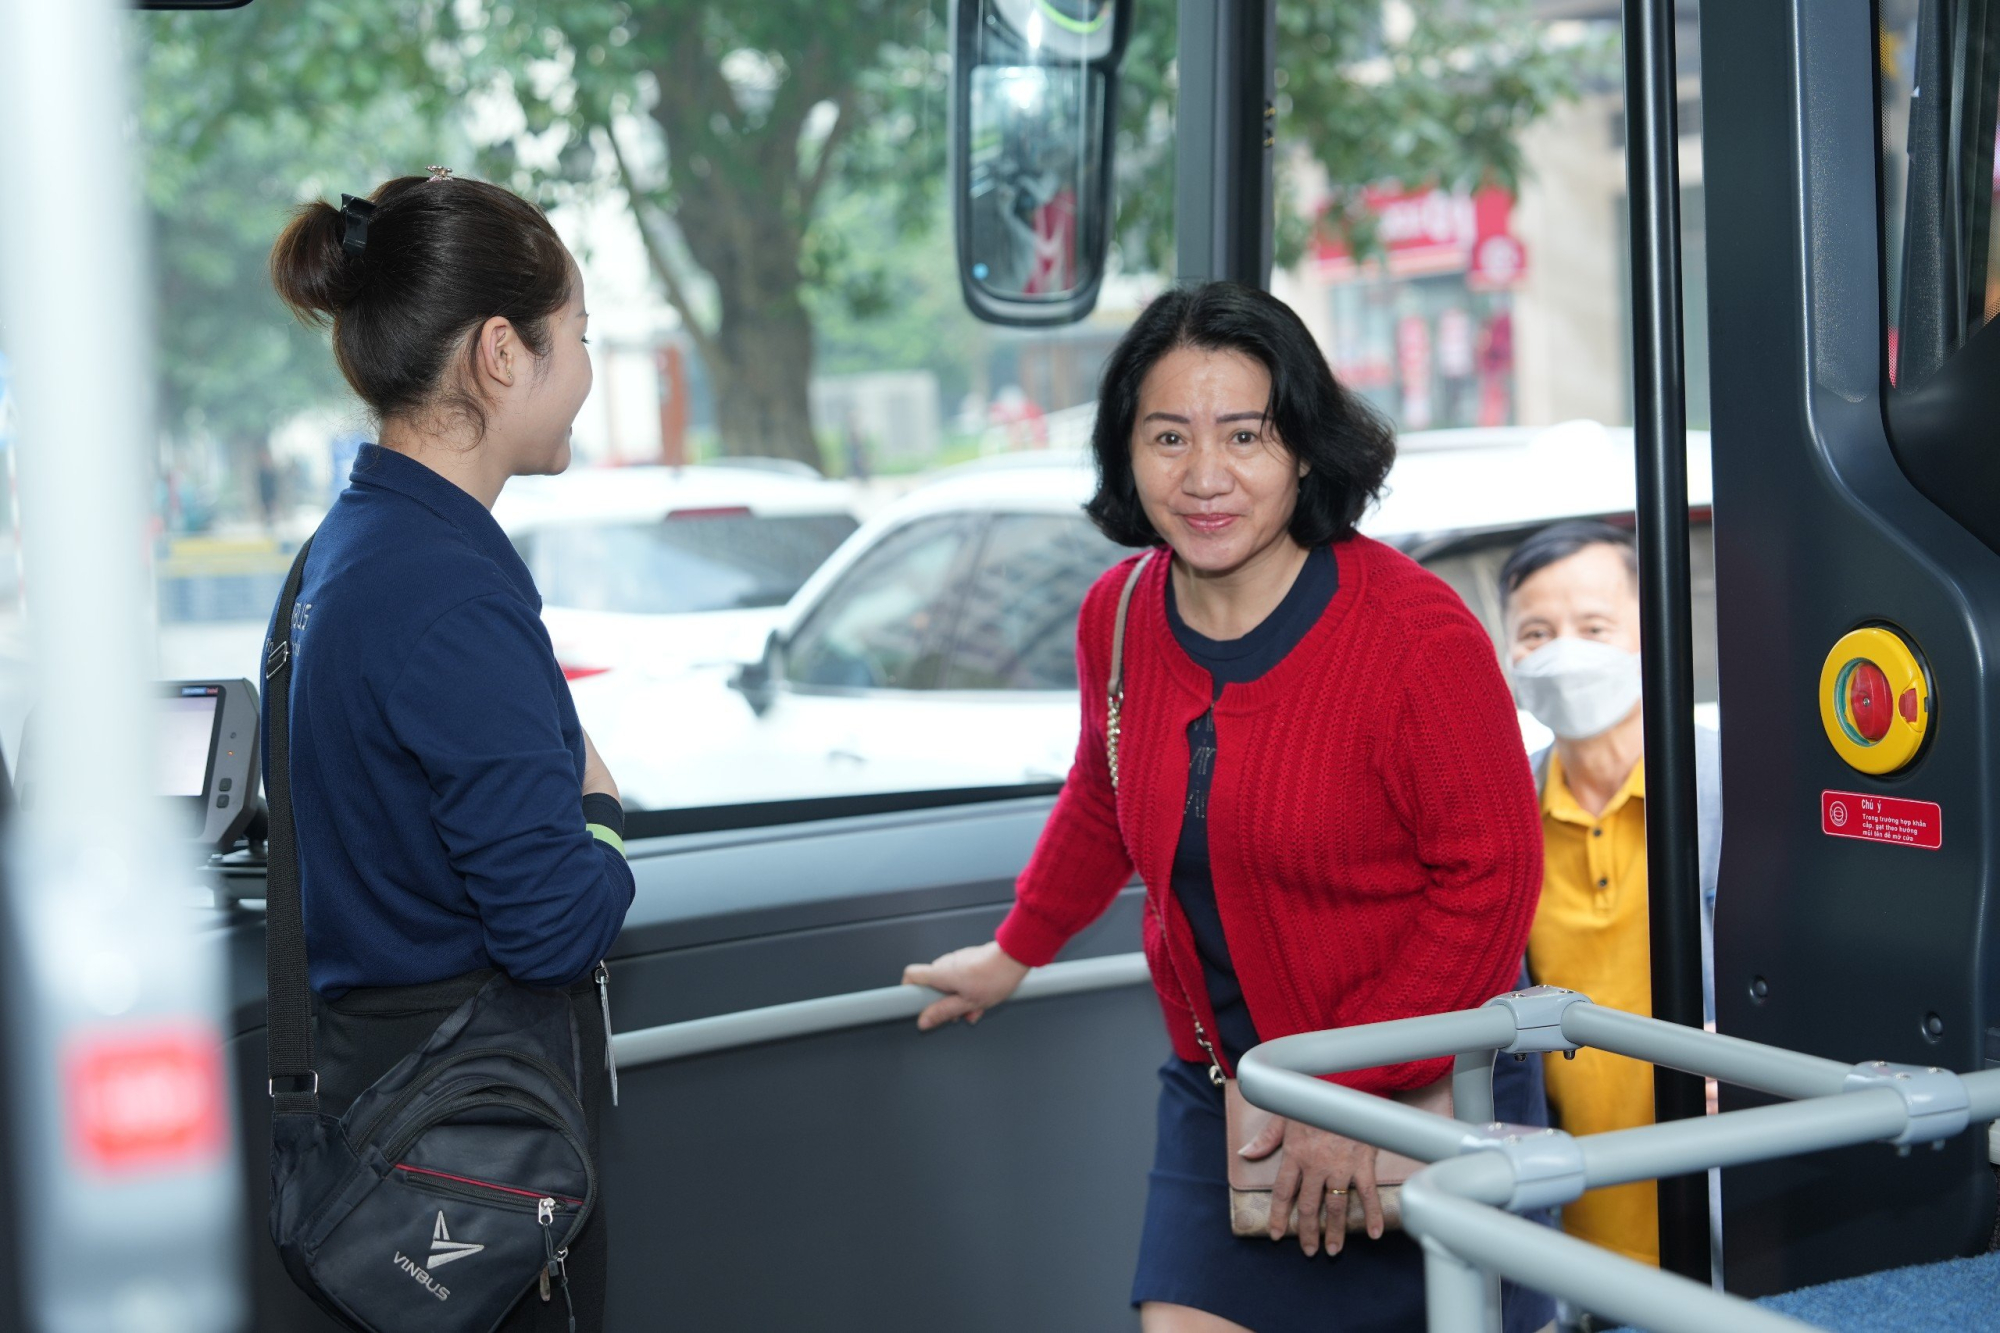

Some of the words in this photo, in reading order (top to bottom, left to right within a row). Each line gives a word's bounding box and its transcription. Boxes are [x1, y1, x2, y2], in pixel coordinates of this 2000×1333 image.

[1862, 799, 1874, 810] Chú
[1877, 800, 1881, 813] ý
[1862, 814, 1878, 823] Trong
[1879, 816, 1899, 825] trường
[1900, 818, 1911, 826] hợp
[1885, 824, 1898, 832] theo
[1899, 826, 1918, 835] hướng
[393, 1251, 451, 1301] VINBUS
